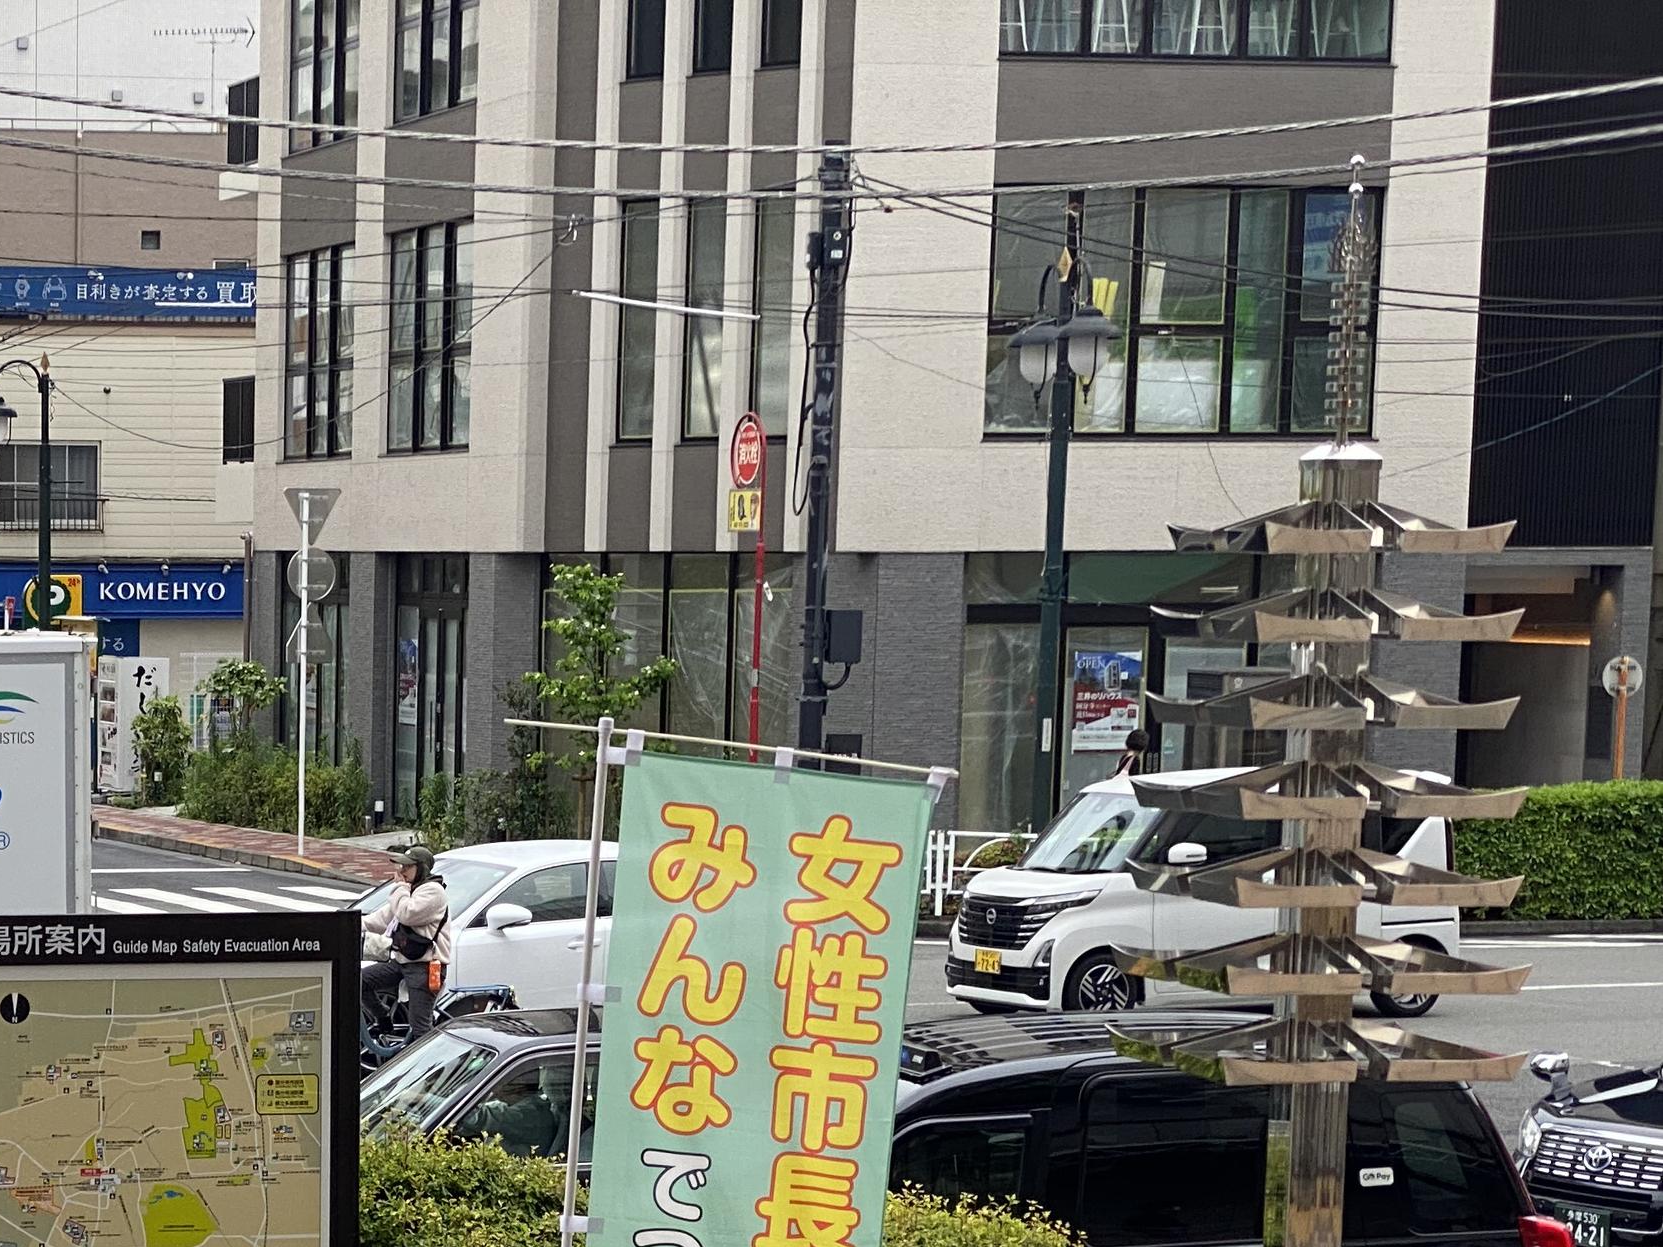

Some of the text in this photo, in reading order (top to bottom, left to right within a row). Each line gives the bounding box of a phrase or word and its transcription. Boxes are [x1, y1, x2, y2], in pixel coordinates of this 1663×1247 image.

[77, 283, 208, 301] 目利きが査定する
[99, 581, 226, 601] KOMEHYO
[113, 939, 149, 954] Guide
[152, 939, 178, 956] Map
[182, 938, 221, 956] Safety
[224, 937, 290, 953] Evacuation
[292, 937, 321, 952] Area
[1583, 1212, 1598, 1225] 530
